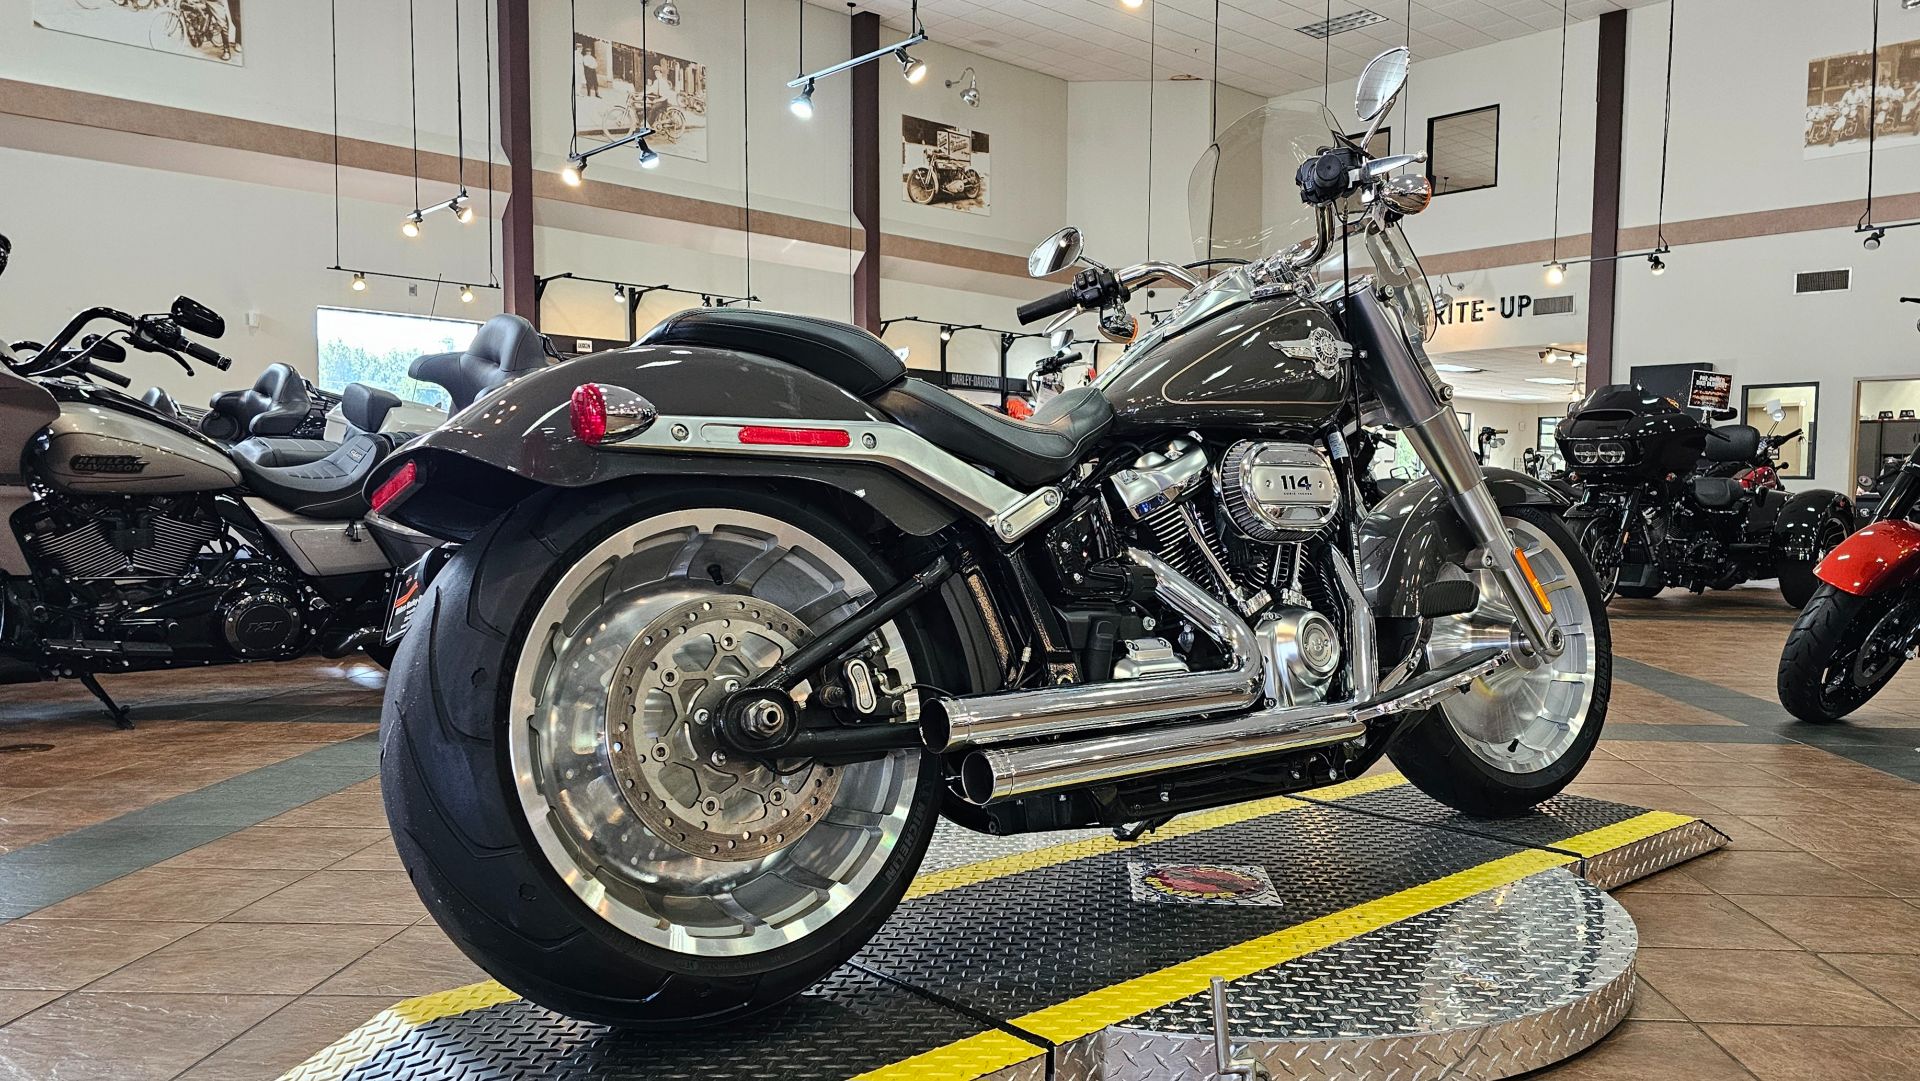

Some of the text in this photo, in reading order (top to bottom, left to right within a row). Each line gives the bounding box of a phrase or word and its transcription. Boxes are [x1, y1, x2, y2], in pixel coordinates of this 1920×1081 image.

[951, 374, 1000, 389] HARLEY-DAVIDSON
[74, 463, 141, 472] DAVIDSON
[1281, 475, 1312, 490] 114
[884, 802, 926, 882] MICHELIN
